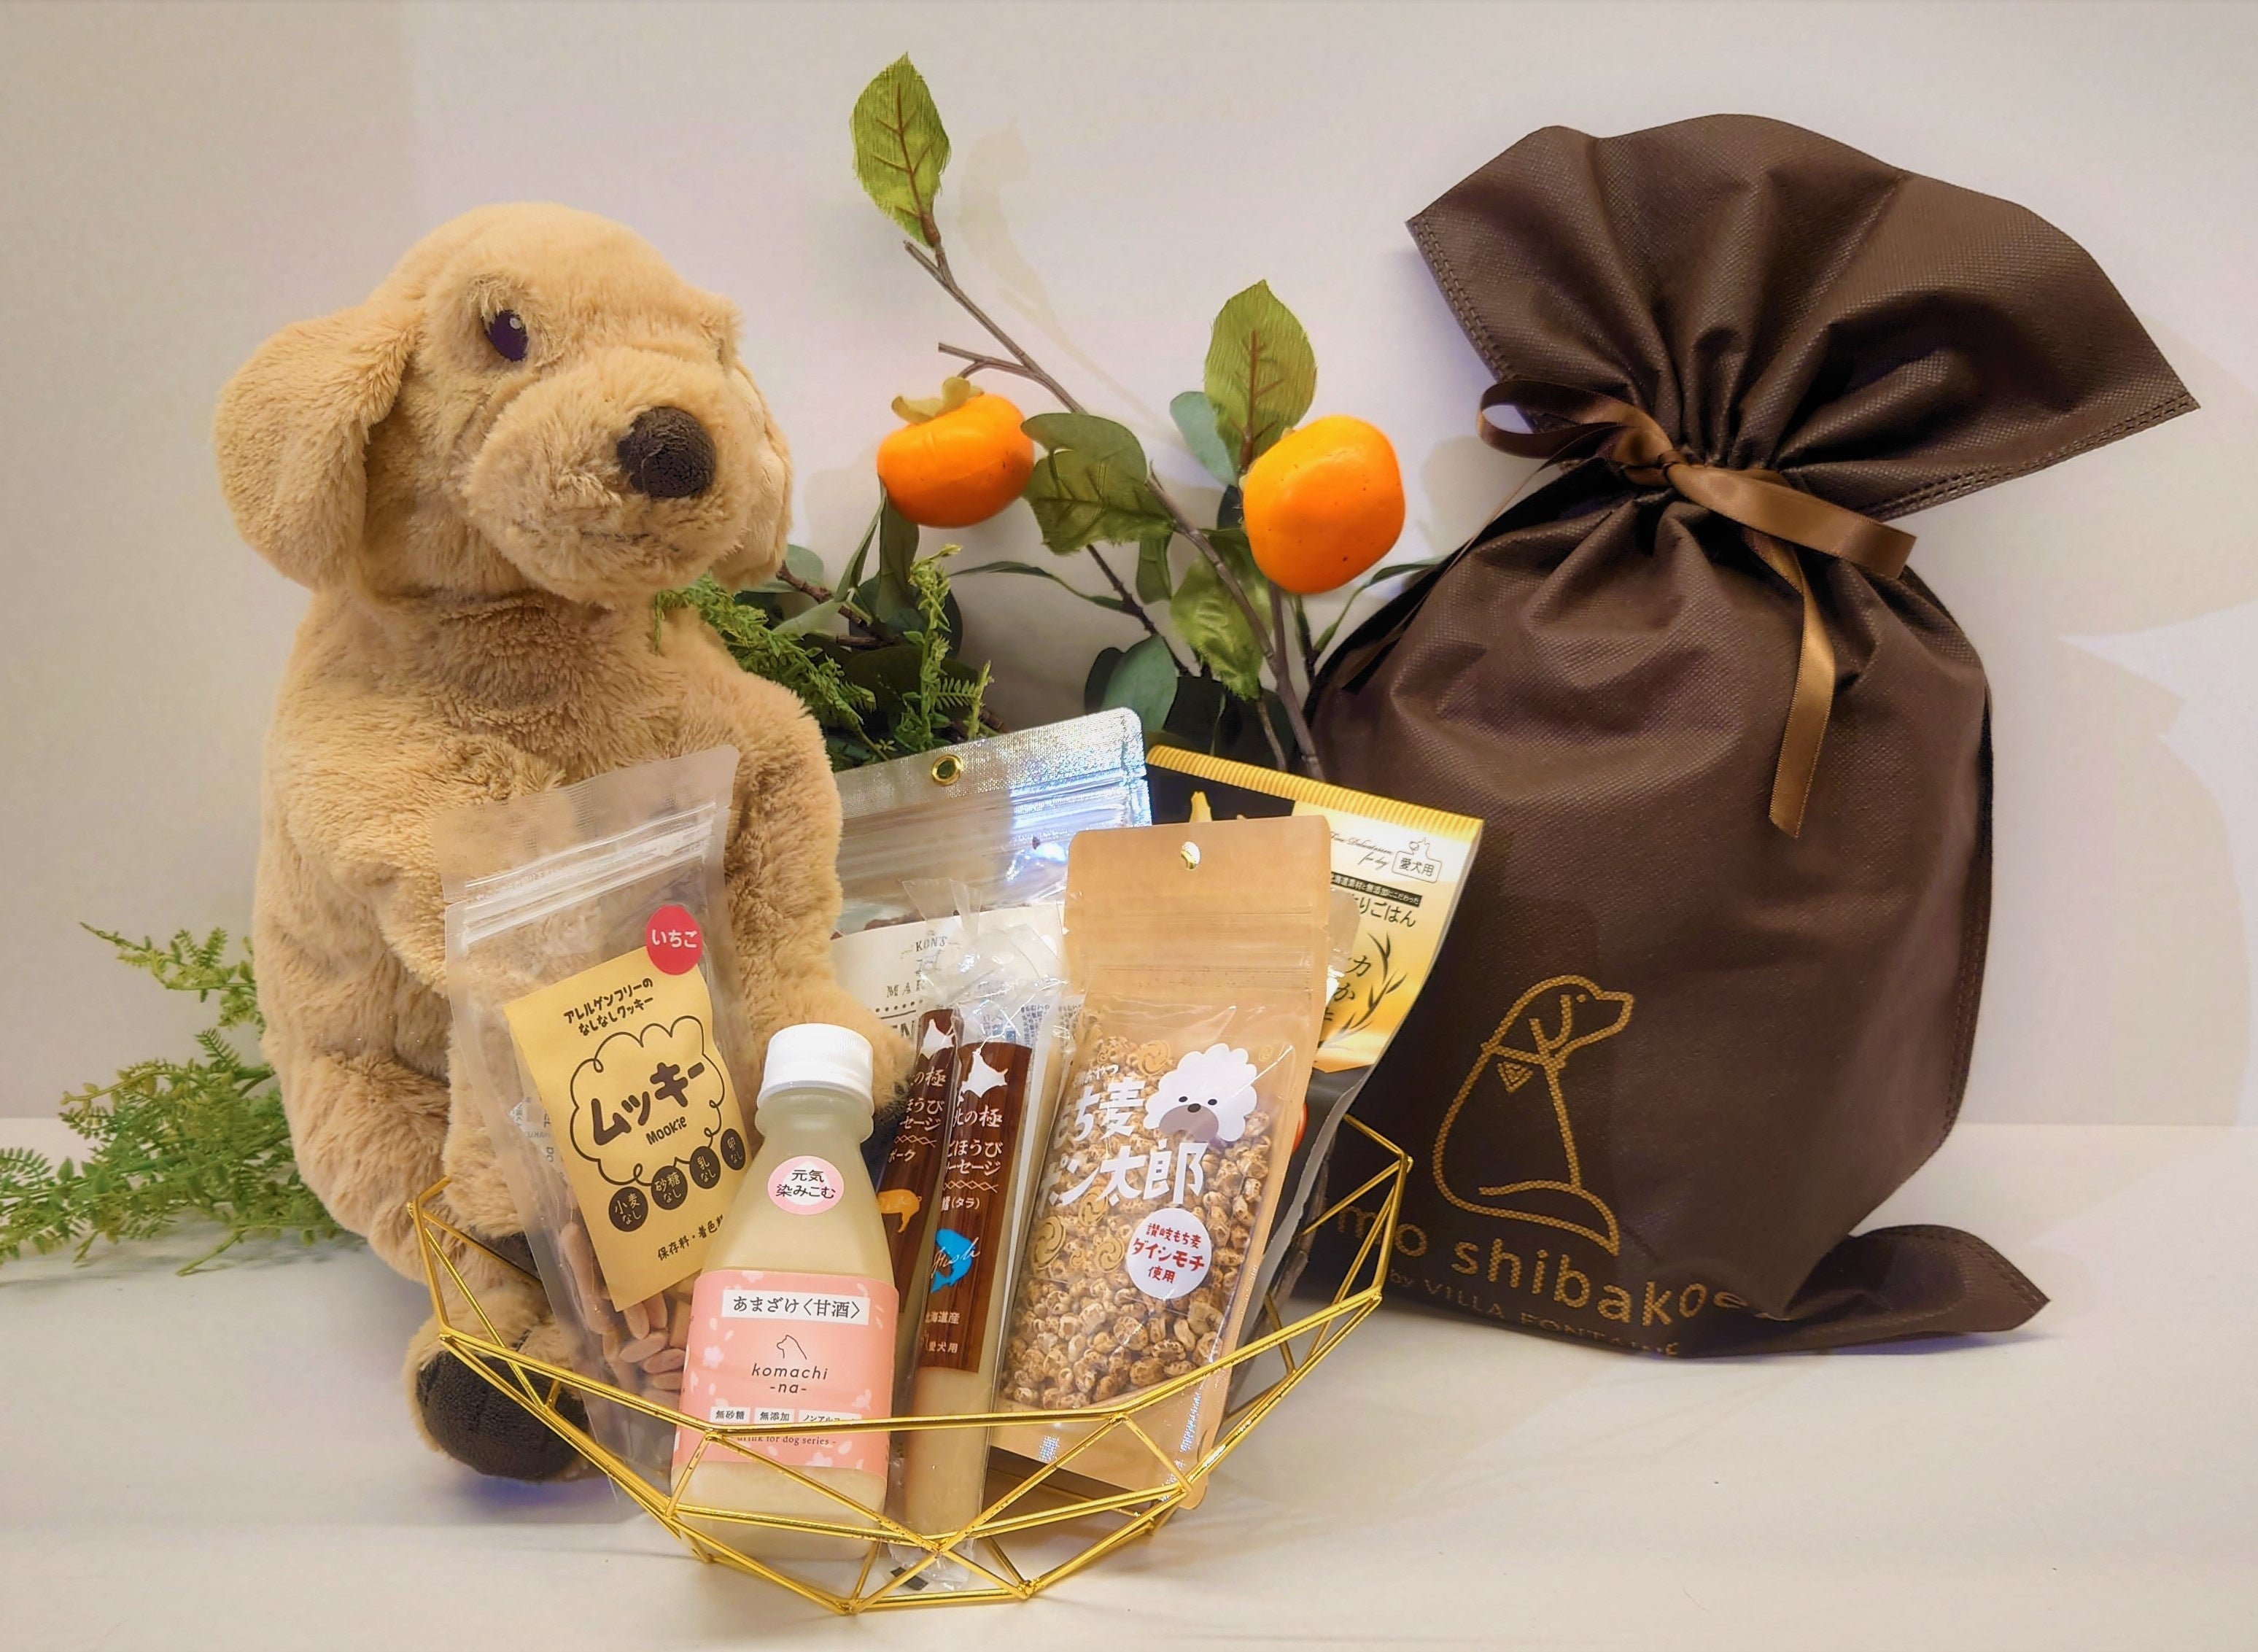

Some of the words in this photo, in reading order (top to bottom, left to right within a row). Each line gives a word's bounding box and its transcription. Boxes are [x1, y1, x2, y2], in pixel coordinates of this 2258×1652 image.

[1398, 857, 1435, 877] 愛犬用
[1330, 873, 1420, 905] 海道素材と無添加にこだわった
[1352, 893, 1416, 928] りごはん
[651, 928, 697, 948] いちご
[564, 977, 653, 1024] アレルゲンフリーの
[578, 996, 653, 1036] なしなしクッキー
[910, 1066, 947, 1087] の極
[590, 1061, 705, 1147] ムッキー
[953, 1104, 1003, 1128] 北の極
[697, 1155, 710, 1170] 乳
[730, 1151, 742, 1163] なし
[700, 1169, 716, 1182] なし
[791, 1169, 825, 1183] 元気
[946, 1159, 1001, 1176] ーセージ
[654, 1171, 680, 1193] 砂糖
[775, 1183, 837, 1199] 染みこむ
[615, 1193, 640, 1215] 小麦
[663, 1188, 682, 1203] なし
[621, 1210, 643, 1225] なし
[1146, 1222, 1201, 1249] 讃岐もち麦
[1131, 1238, 1205, 1272] ダイシモチ
[1148, 1265, 1176, 1284] 使用
[1453, 1238, 1749, 1327] shibakoe
[1424, 1279, 1506, 1319] VILLA
[751, 1362, 829, 1380] komachi
[715, 1409, 745, 1421] 無砂糖
[759, 1411, 790, 1422] 無添加
[783, 1435, 799, 1446] dog
[802, 1437, 830, 1446] series
